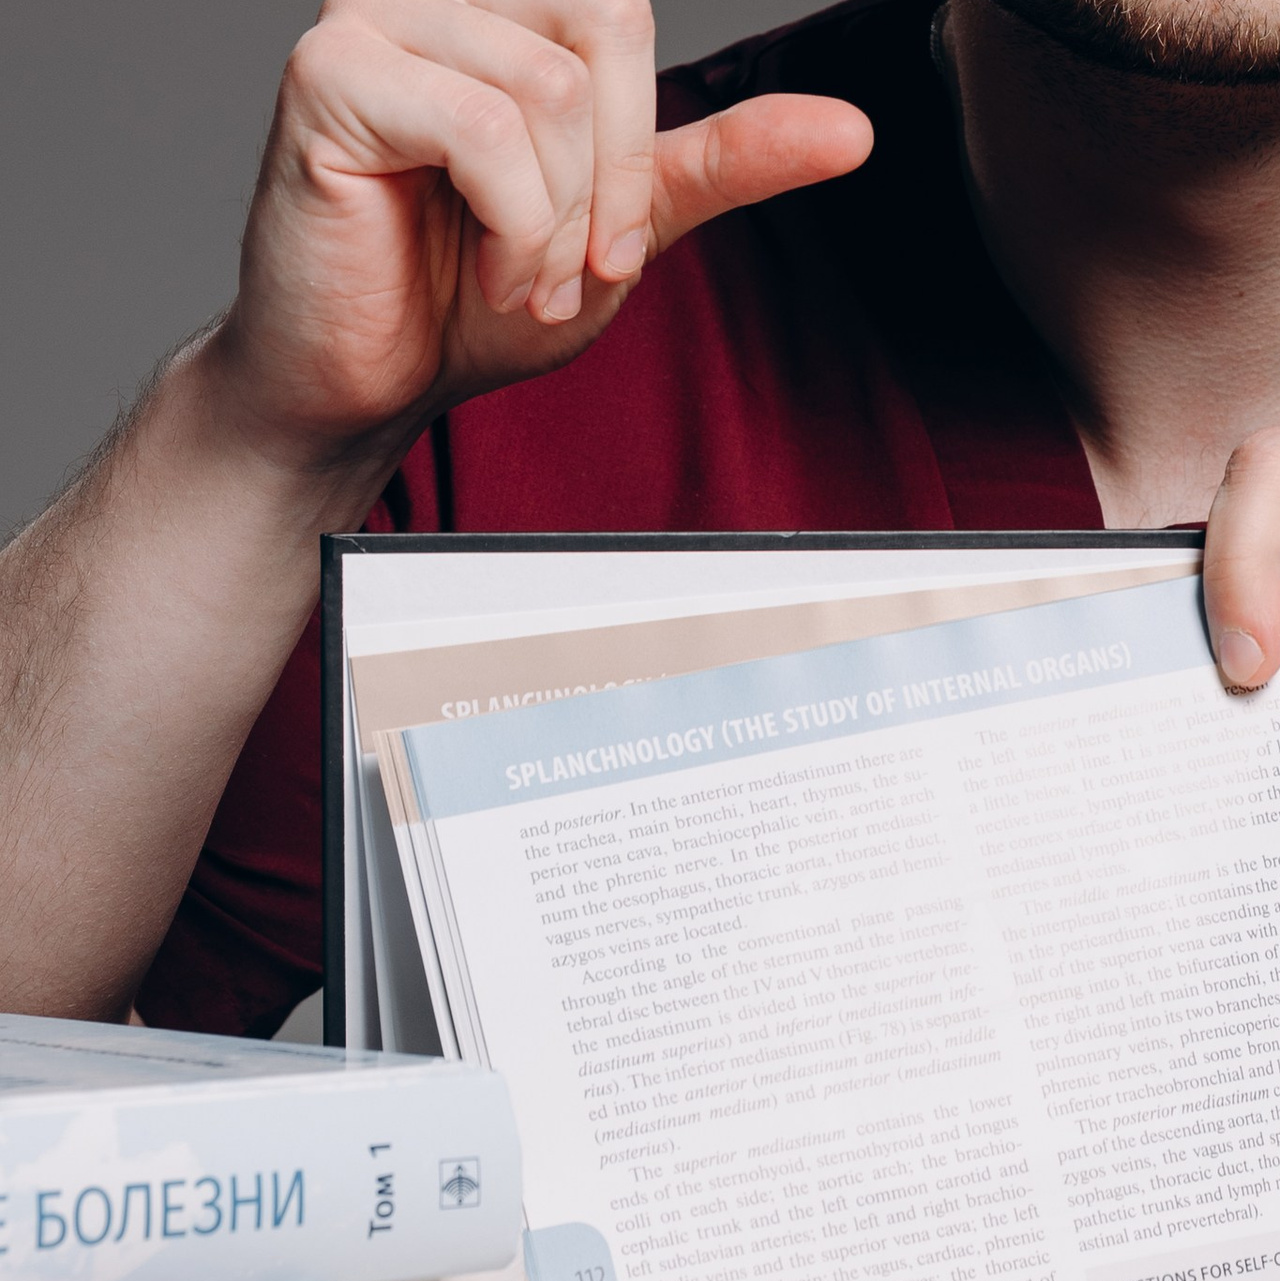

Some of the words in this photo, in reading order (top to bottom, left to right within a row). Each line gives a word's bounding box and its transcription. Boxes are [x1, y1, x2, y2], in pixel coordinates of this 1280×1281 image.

[506, 725, 713, 789] SPLANCHNOLOGY
[722, 713, 778, 747] (THE
[783, 696, 857, 732] STUDY
[867, 689, 895, 715] OF
[903, 665, 1021, 708] INTERNAL
[1026, 642, 1131, 683] ORGANS)
[370, 1143, 392, 1157] 1
[36, 1169, 306, 1250] БОЛЕЗНИ
[368, 1173, 395, 1239] Том
[1201, 1263, 1232, 1280] FOR
